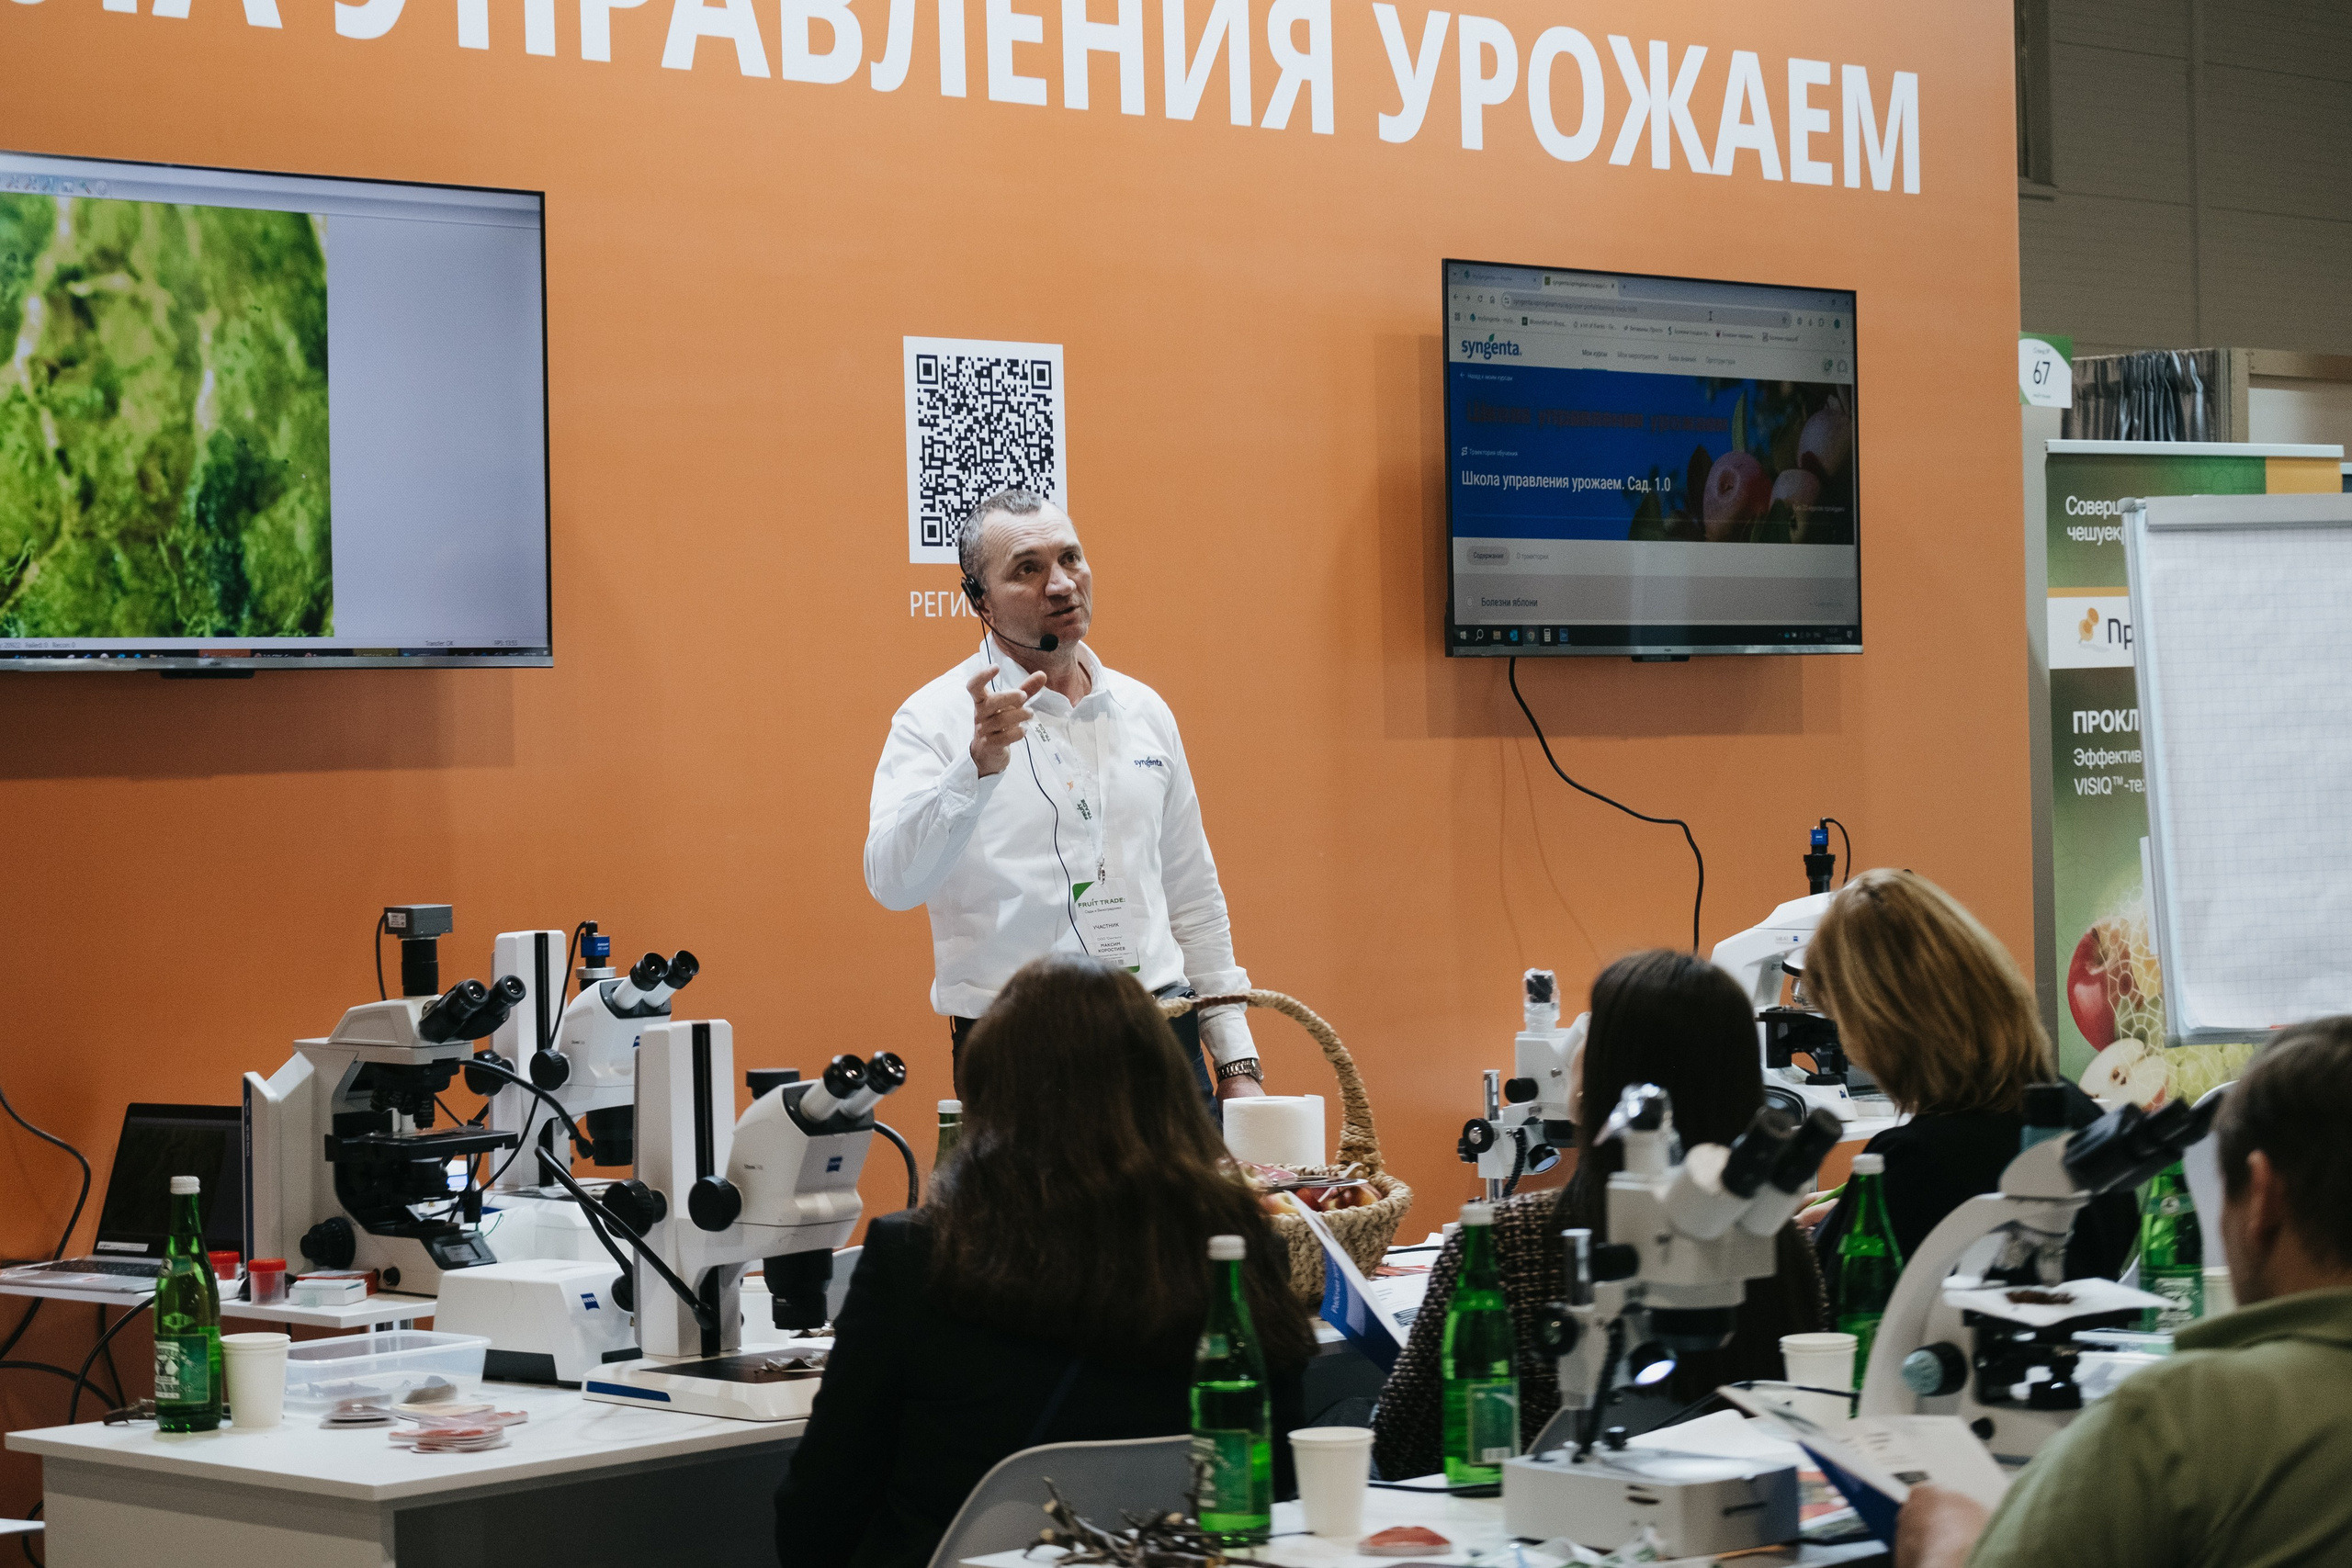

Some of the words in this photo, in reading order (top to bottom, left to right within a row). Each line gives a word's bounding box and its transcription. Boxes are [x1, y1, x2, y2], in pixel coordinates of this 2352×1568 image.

[334, 0, 1334, 135] АВЛЕНИЯ
[1372, 1, 1920, 195] УРОЖАЕМ
[2032, 360, 2051, 385] 67
[1462, 470, 1500, 486] Школа
[1502, 473, 1569, 491] управления
[1572, 477, 1625, 492] урожаем.
[1627, 476, 1652, 493] Сад.
[1655, 477, 1671, 492] 1.0
[1481, 597, 1511, 606] Болезни
[1512, 597, 1538, 606] яблони
[2073, 708, 2140, 734] ПРОКЛ
[2073, 747, 2143, 770] Эффектив
